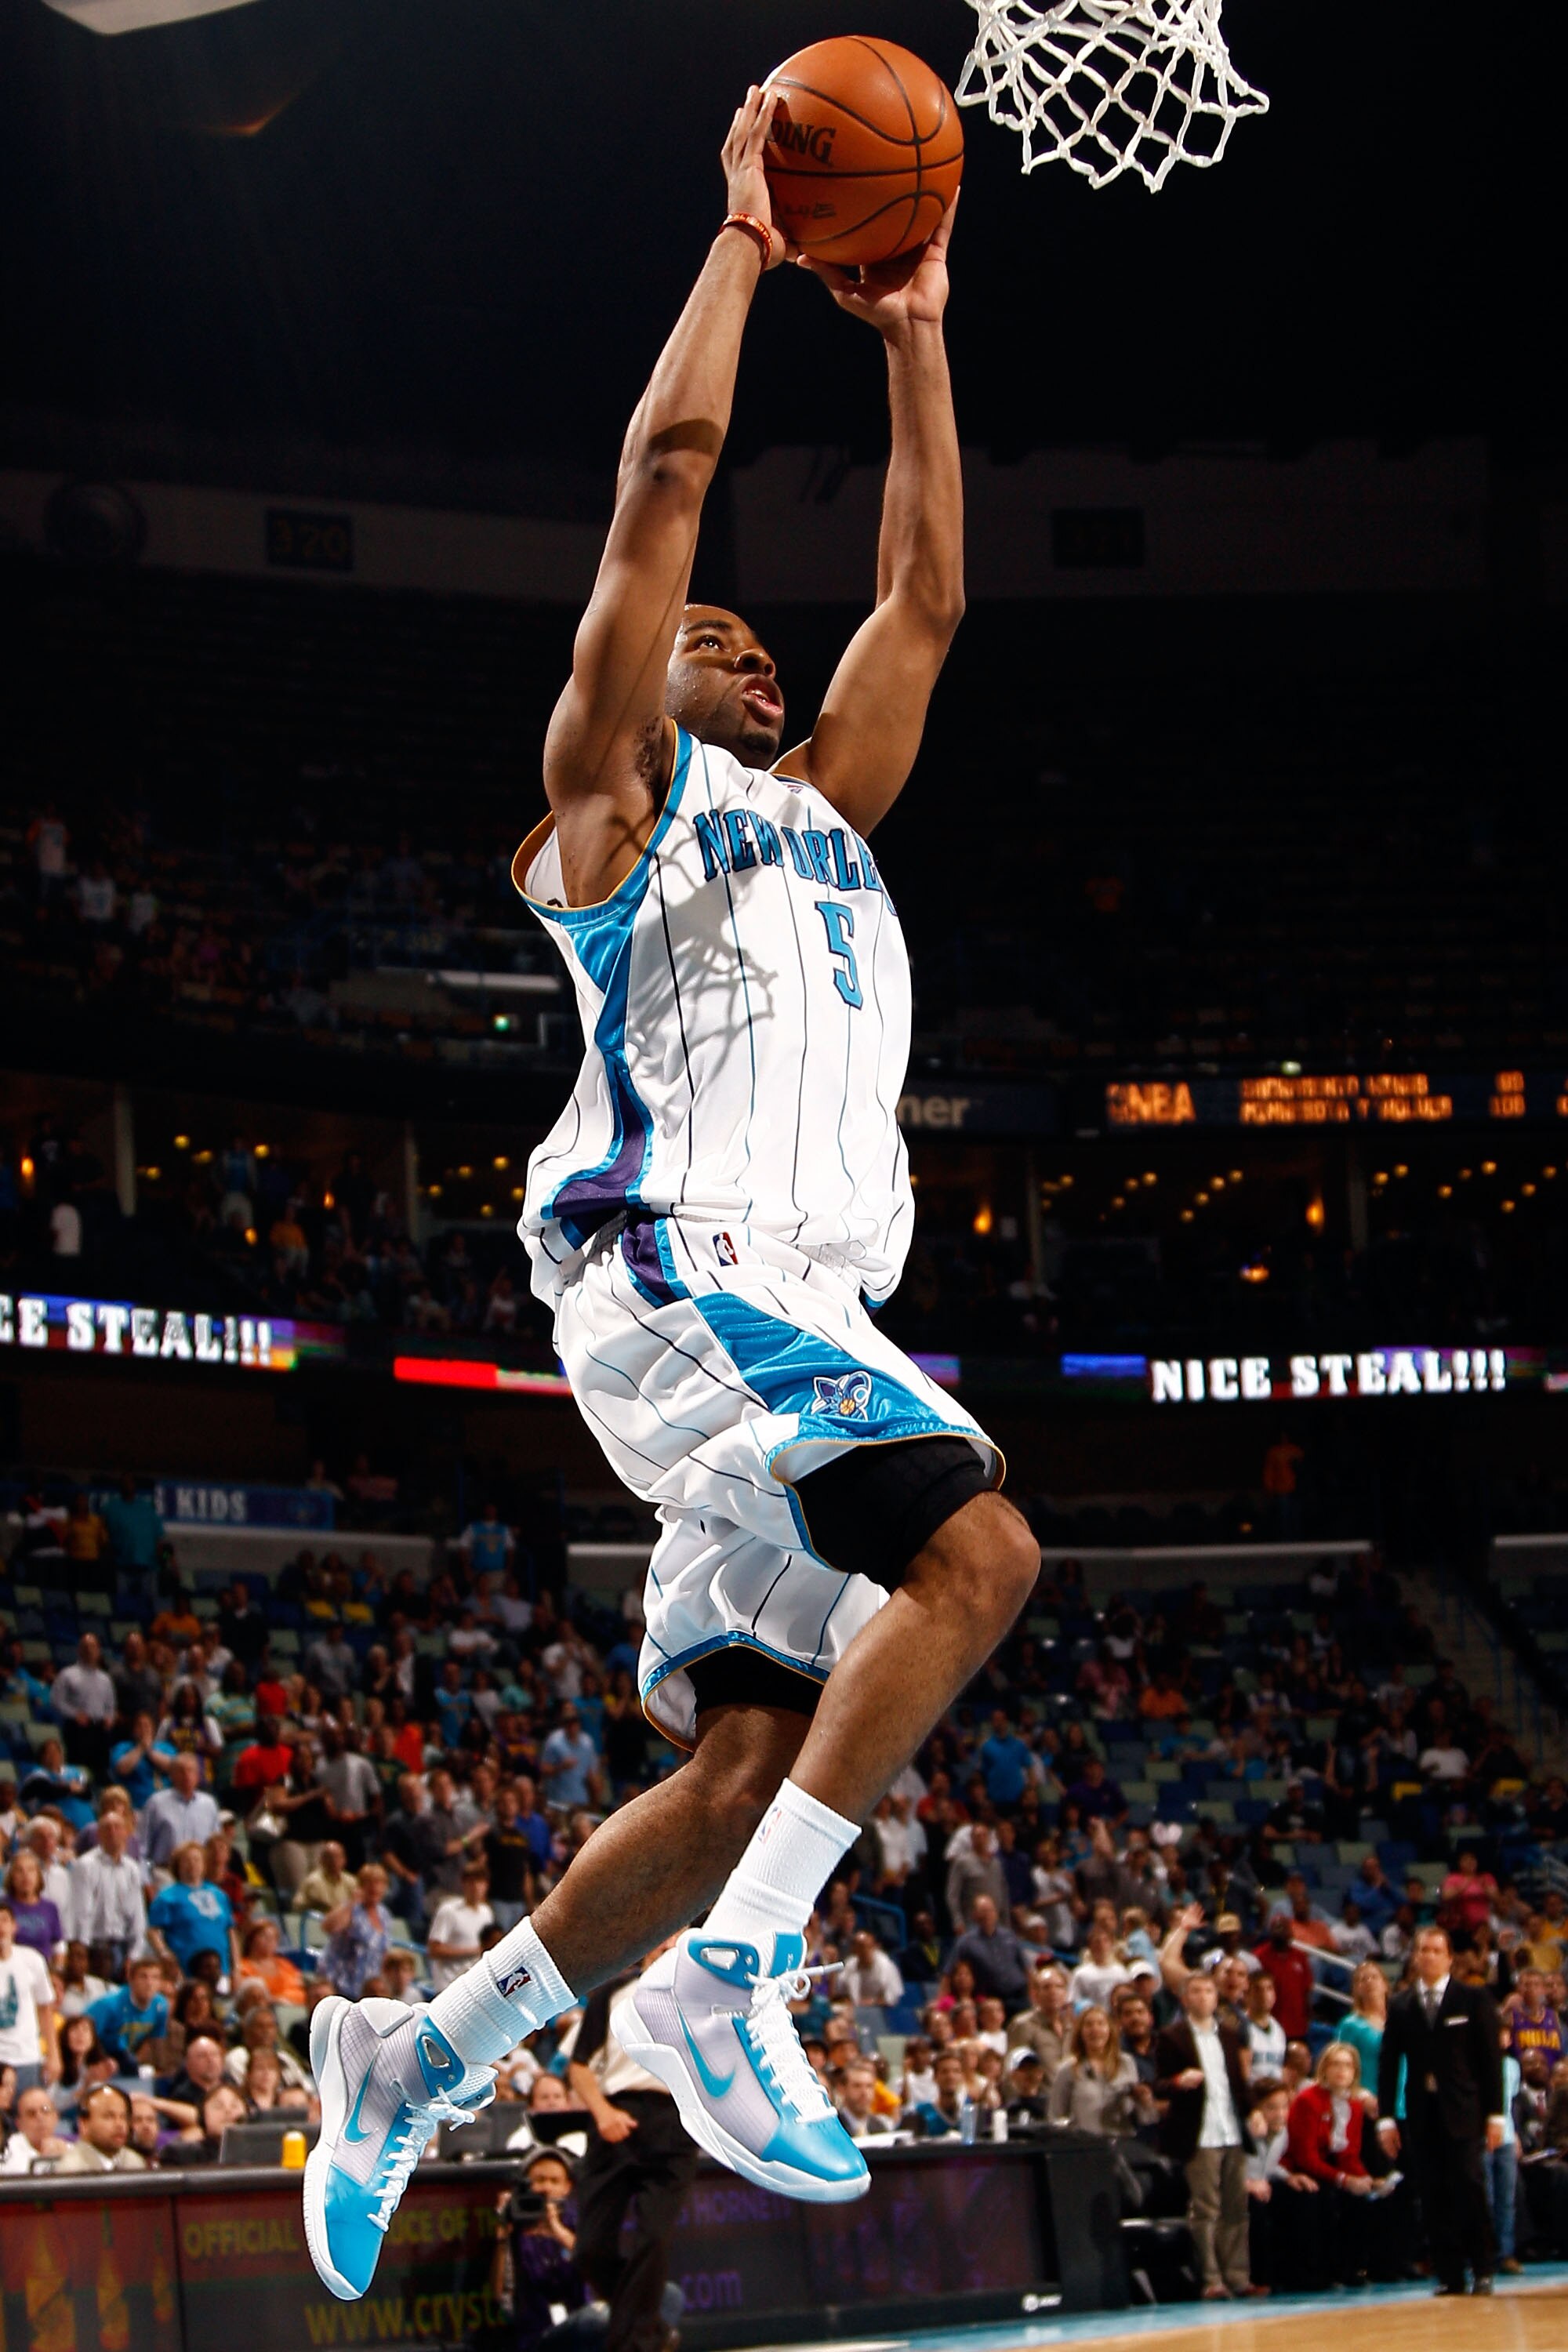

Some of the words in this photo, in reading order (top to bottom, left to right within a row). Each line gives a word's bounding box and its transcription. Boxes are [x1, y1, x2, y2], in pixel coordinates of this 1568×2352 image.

[693, 808, 785, 882] NEW
[781, 826, 898, 917] ORLE
[814, 900, 863, 1011] 5
[895, 1094, 971, 1126] ner
[67, 1301, 272, 1365] STEAL!!!
[1150, 1357, 1272, 1403] NICE
[1290, 1348, 1507, 1398] STEAL!!!
[176, 1486, 248, 1523] KIDS
[183, 2217, 302, 2259] OFFICIAL
[438, 2206, 470, 2242] OF
